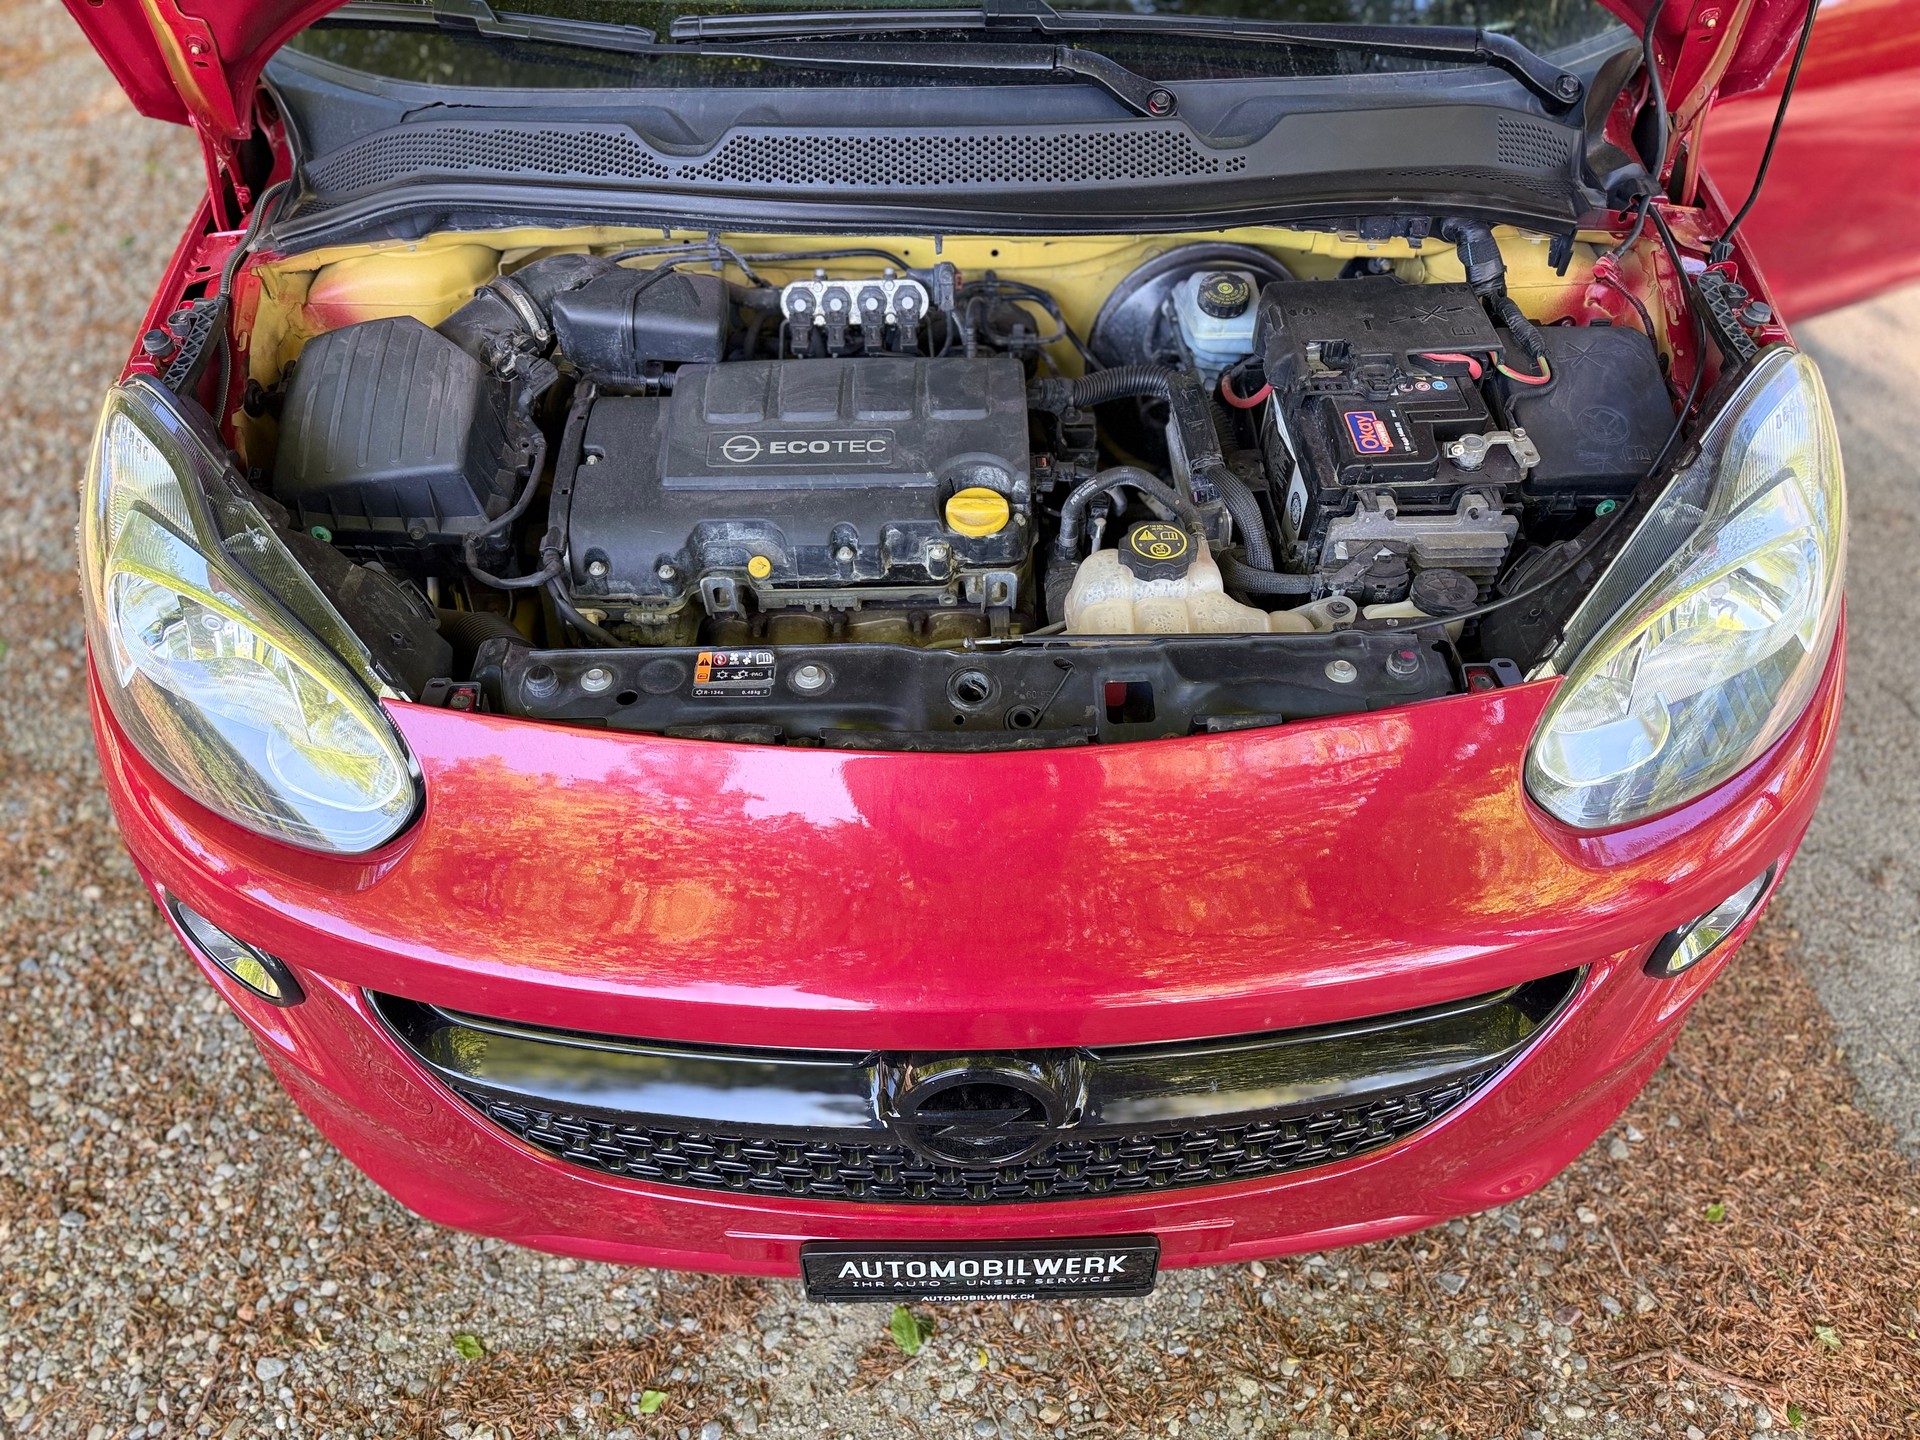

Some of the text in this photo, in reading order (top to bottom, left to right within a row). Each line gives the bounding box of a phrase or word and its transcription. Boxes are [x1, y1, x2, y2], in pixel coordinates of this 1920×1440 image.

[1355, 415, 1380, 449] Okay
[769, 439, 887, 454] ECOTEC
[838, 1256, 1128, 1278] AUTOMOBILWERK
[852, 1280, 886, 1288] IHR
[966, 1278, 1026, 1287] UNSER
[1034, 1275, 1112, 1285] SERVICE
[920, 1293, 1036, 1302] AUTOMOBILWERK.CH
